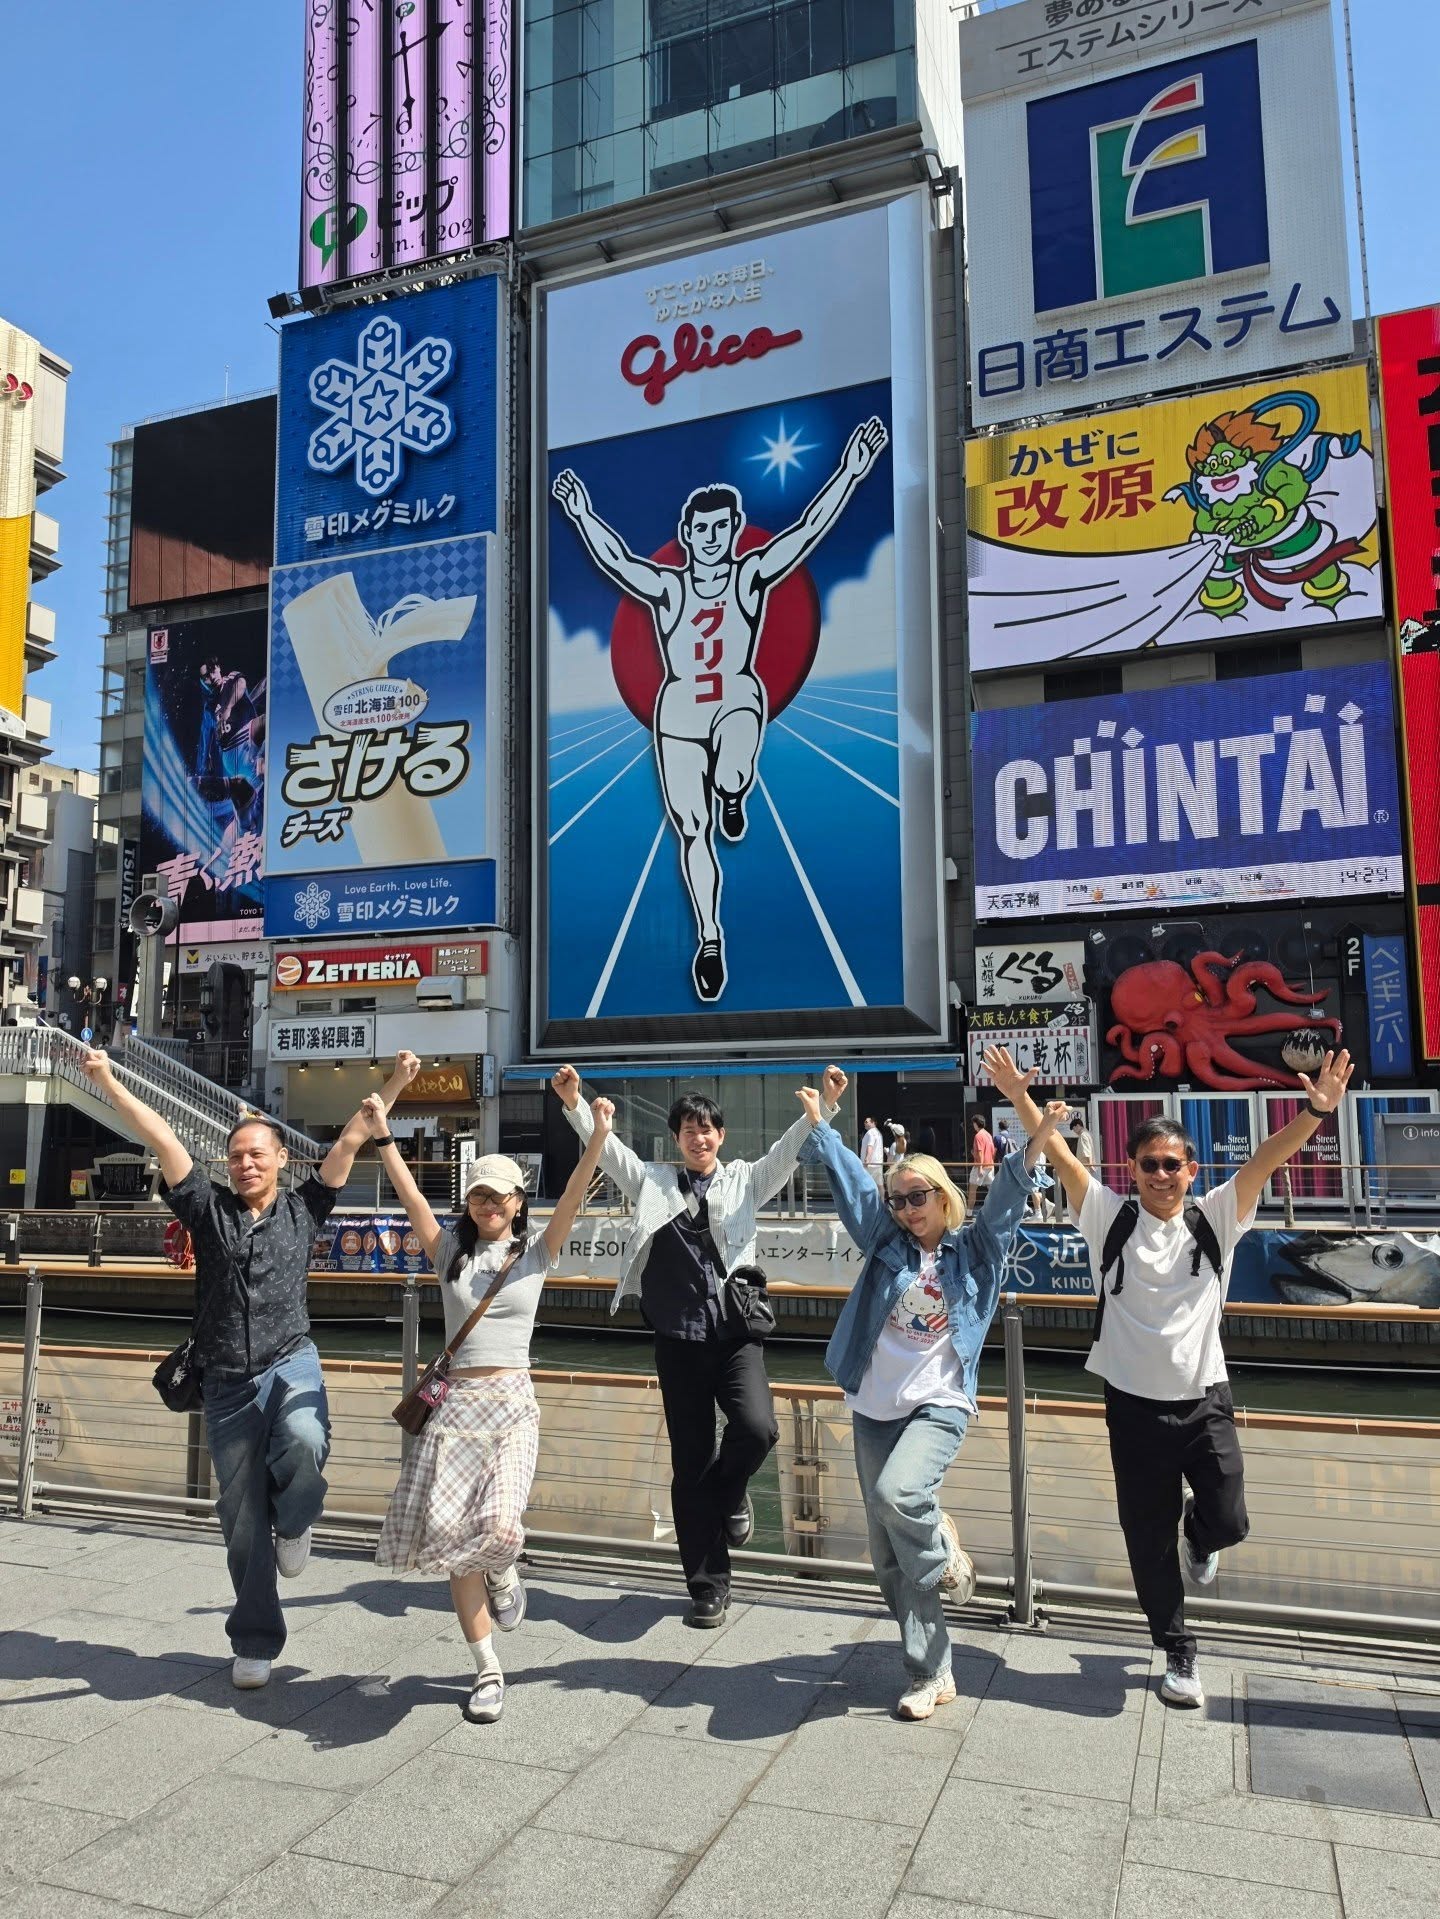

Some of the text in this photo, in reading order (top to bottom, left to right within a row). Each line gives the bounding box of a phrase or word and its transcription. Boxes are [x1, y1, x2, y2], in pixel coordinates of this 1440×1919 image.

[377, 176, 459, 230] ピップ
[645, 258, 774, 305] すこやかな毎日、
[656, 282, 762, 321] ゆたかな人生
[978, 283, 1341, 397] 日商エステム
[1009, 429, 1140, 477] かぜに
[995, 459, 1156, 537] 改源
[304, 494, 455, 542] 雪印メグミルク
[691, 600, 727, 703] グリコ
[351, 684, 400, 699] STRING CHEESE
[283, 723, 468, 805] さける
[282, 808, 351, 846] チーズ
[344, 877, 452, 894] Love Earth. Love Life.
[1341, 867, 1387, 883] 14:29
[337, 894, 459, 923] 雪印メグミルク
[986, 892, 1040, 911] 天気予報
[306, 959, 421, 983] ZETTERIA
[384, 953, 411, 961] ゼッテリア
[995, 950, 1064, 994] くくる
[981, 952, 997, 999] 道頓堀
[969, 1008, 1053, 1028] 大阪もんを食す
[1071, 1016, 1086, 1026] 2F
[1371, 947, 1404, 1063] ペンギンバー
[976, 1037, 1072, 1076] 大に乾杯
[1227, 1135, 1248, 1144] Street
[1315, 1135, 1336, 1143] Street
[1421, 1128, 1440, 1137] info
[1048, 1233, 1087, 1268] 近
[1051, 1276, 1093, 1289] KIND
